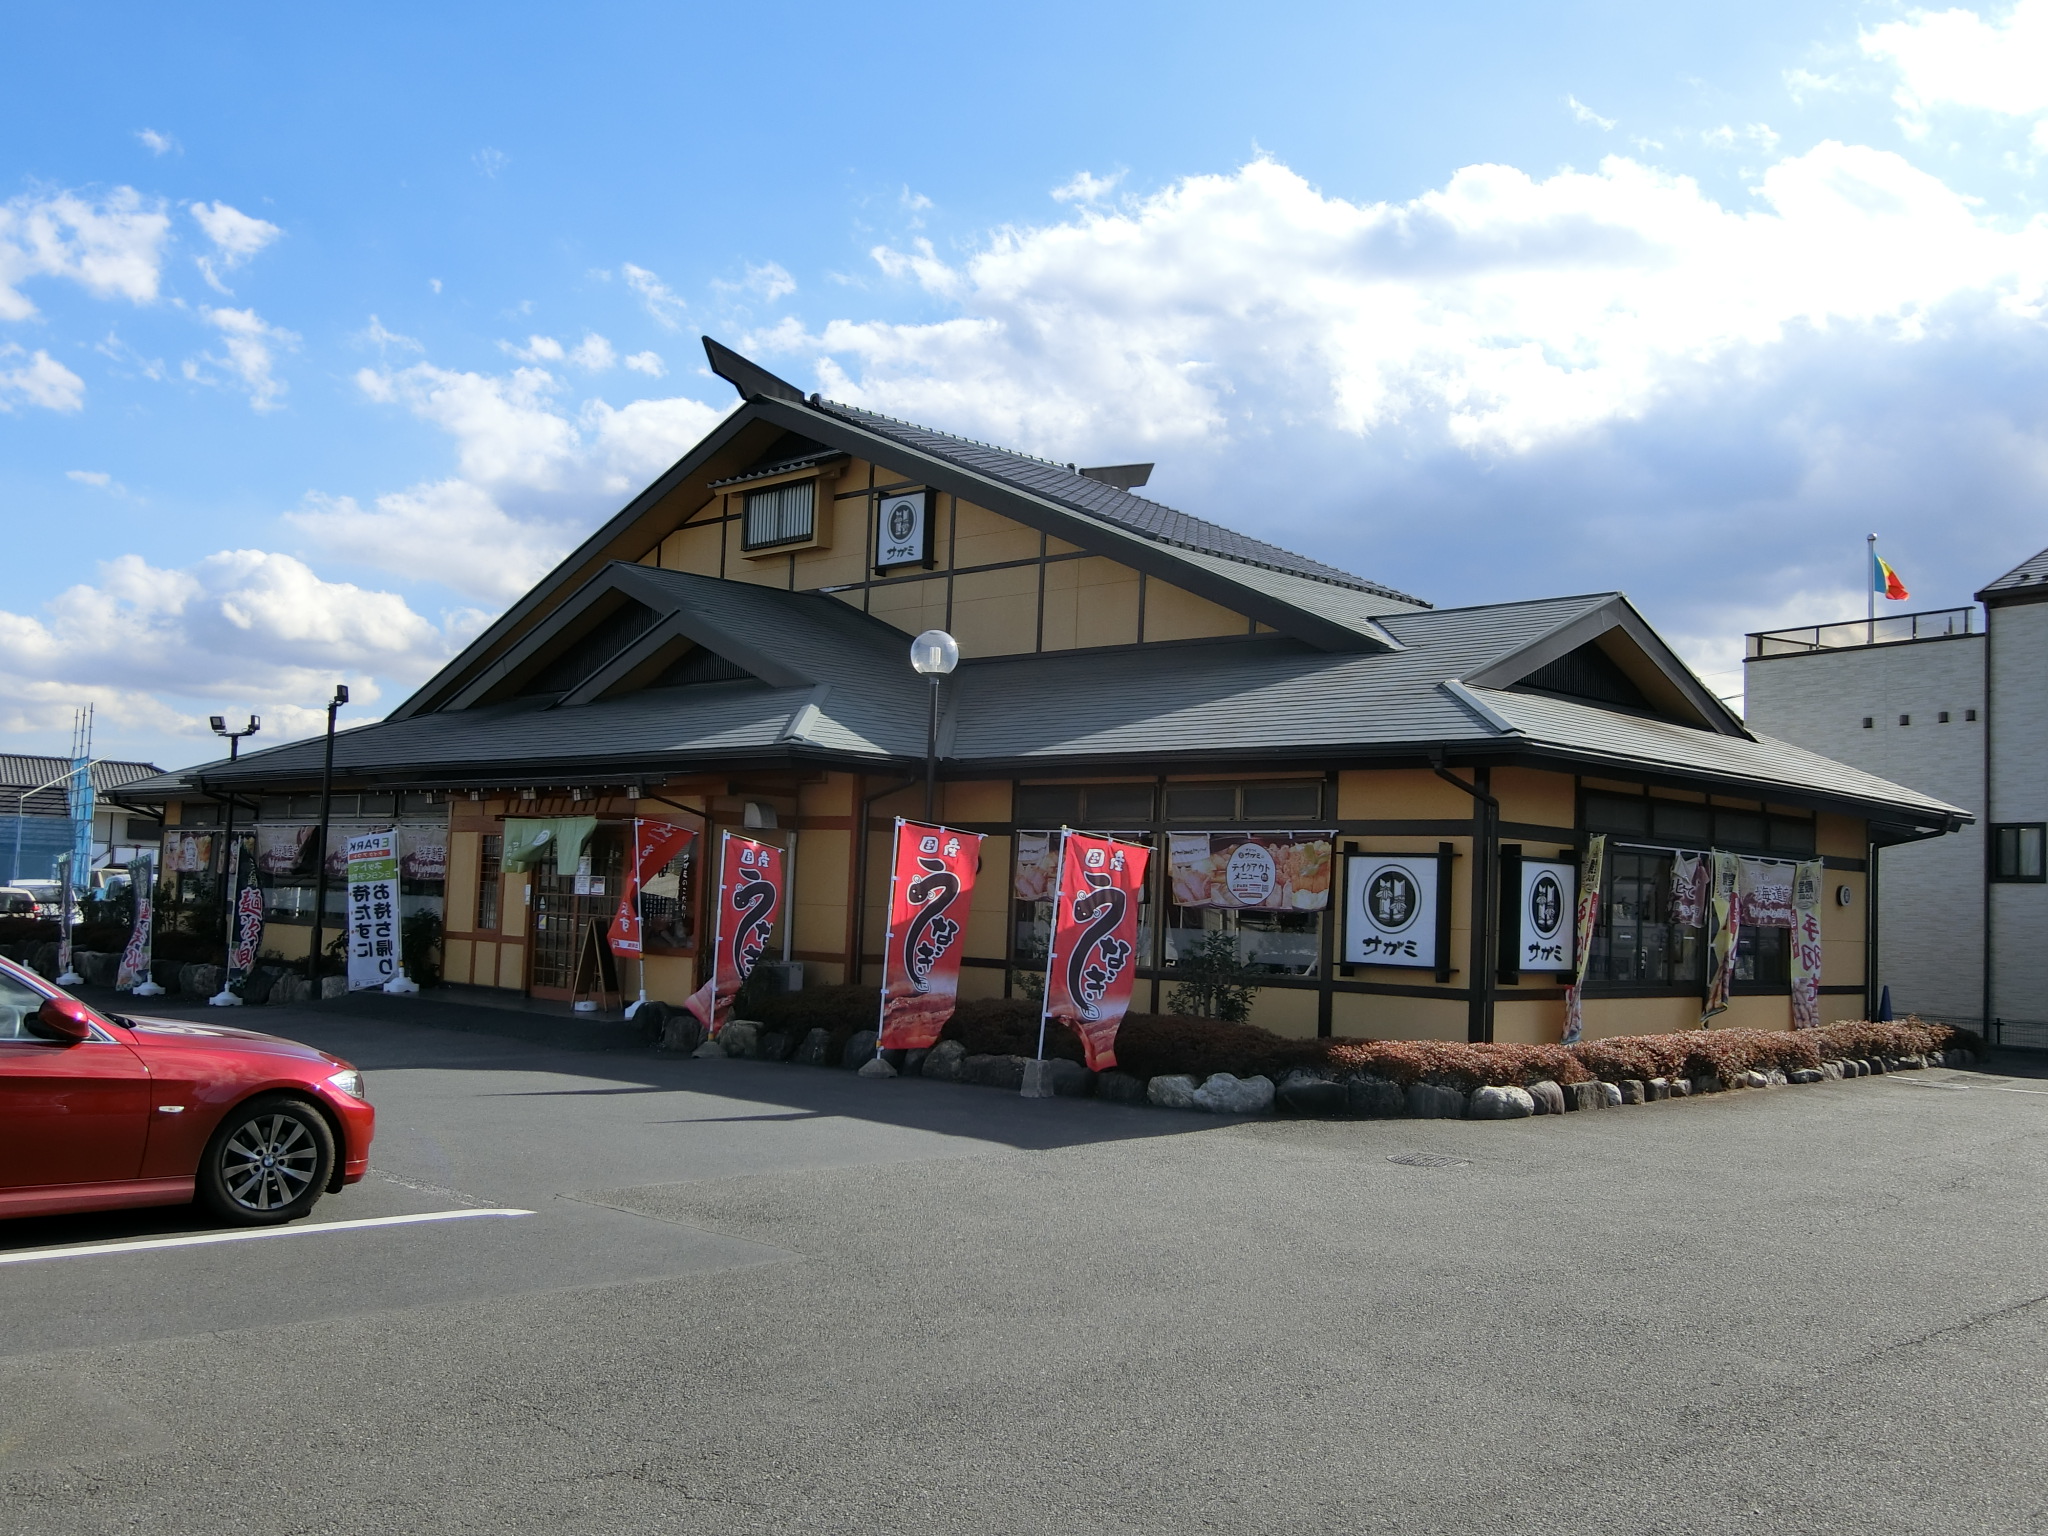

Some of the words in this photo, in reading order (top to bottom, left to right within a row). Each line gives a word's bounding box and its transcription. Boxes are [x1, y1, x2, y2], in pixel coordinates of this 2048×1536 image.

[887, 546, 914, 560] サガミ
[919, 836, 961, 858] 国産
[741, 849, 770, 868] 国産
[1085, 848, 1126, 872] 国産
[1231, 862, 1270, 874] テイクアウト
[1363, 935, 1418, 958] サガミ
[1528, 941, 1563, 962] サガミ
